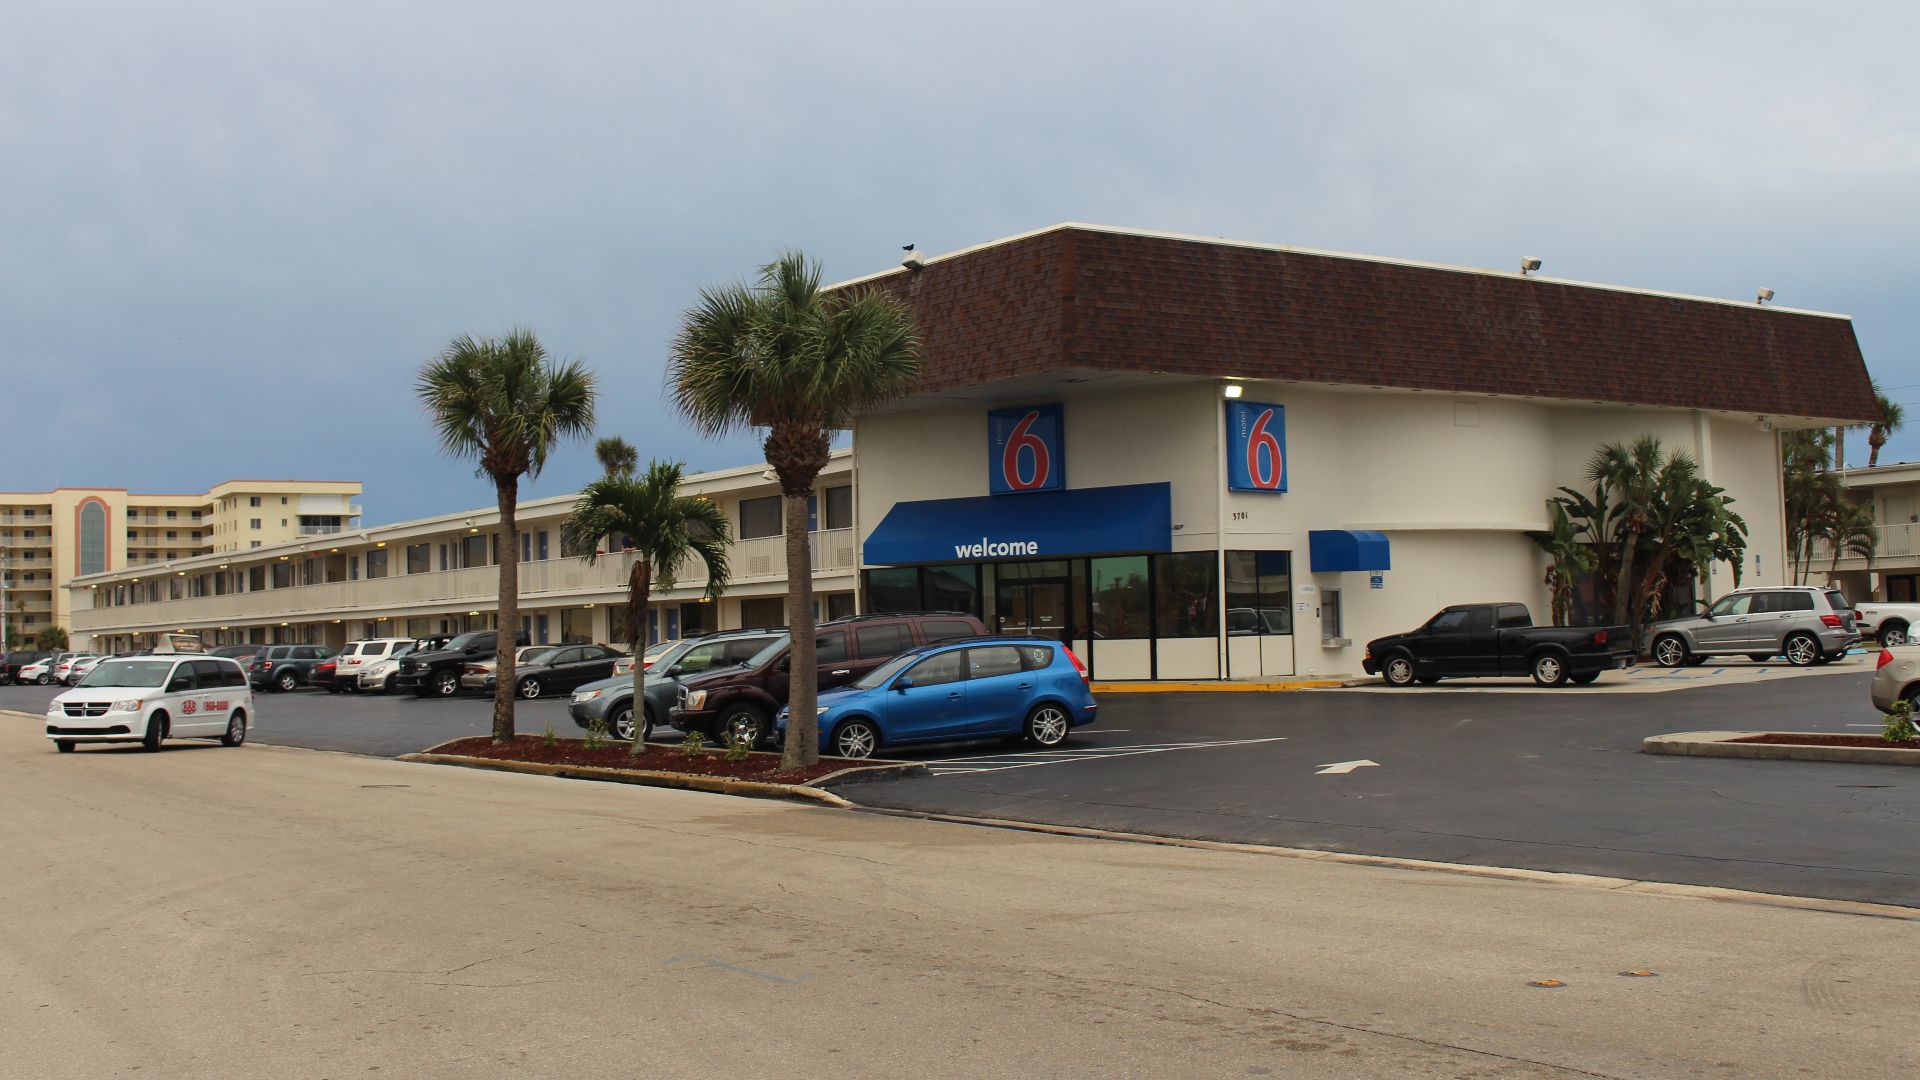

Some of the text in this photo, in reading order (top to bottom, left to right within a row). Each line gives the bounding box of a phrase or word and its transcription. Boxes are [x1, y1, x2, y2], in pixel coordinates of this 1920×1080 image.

[1003, 410, 1050, 490] 6
[1247, 409, 1283, 489] 6
[955, 537, 1038, 559] welcome
